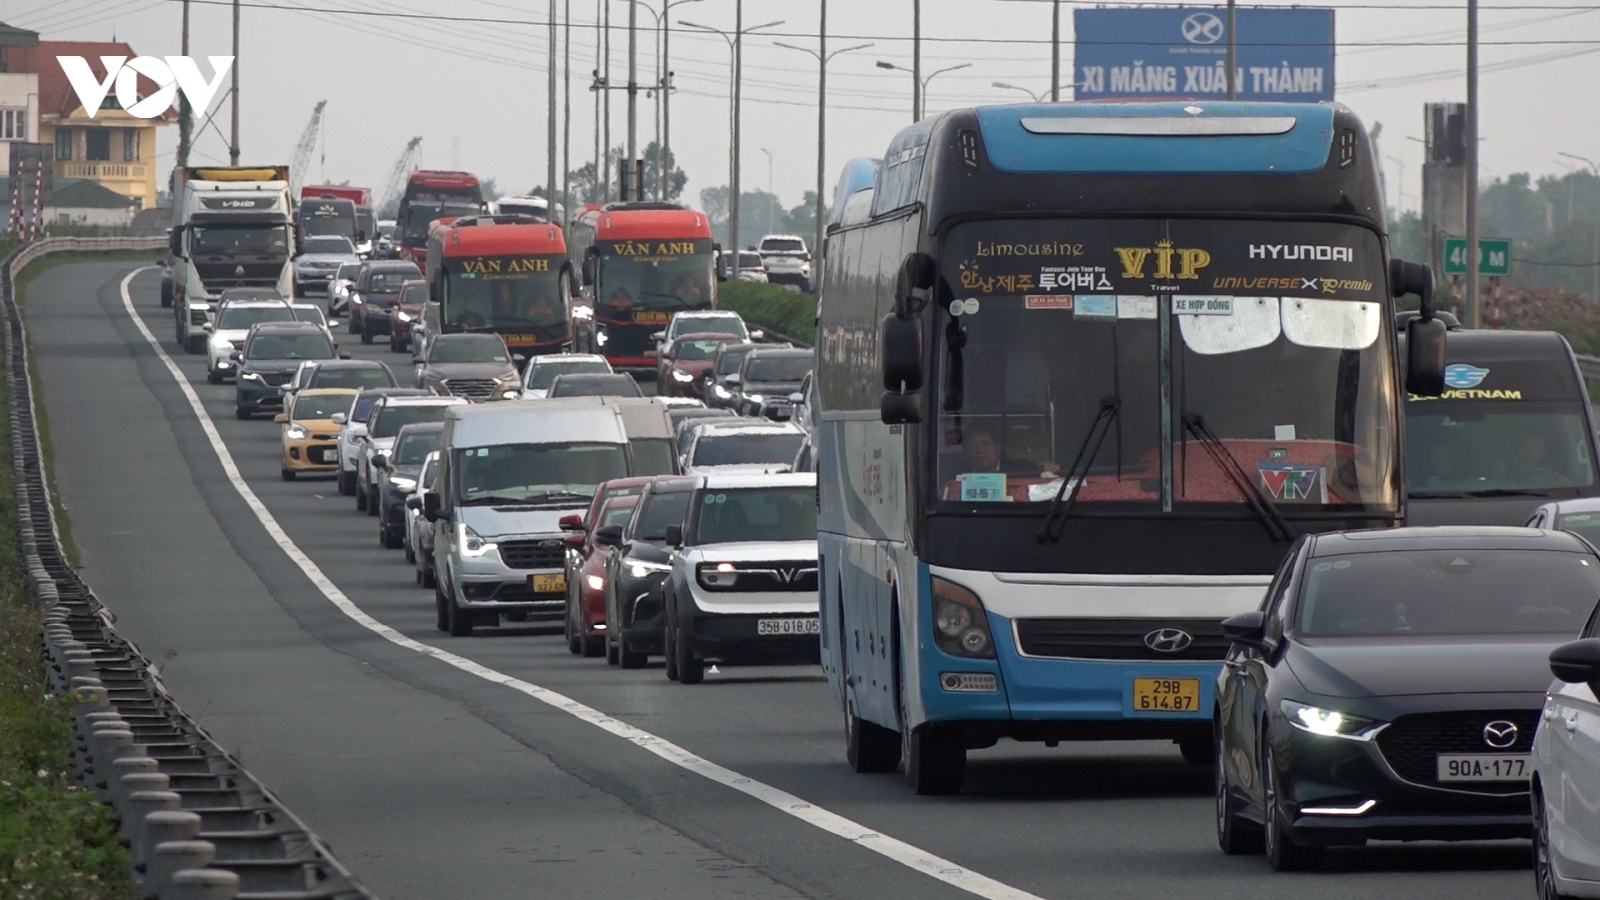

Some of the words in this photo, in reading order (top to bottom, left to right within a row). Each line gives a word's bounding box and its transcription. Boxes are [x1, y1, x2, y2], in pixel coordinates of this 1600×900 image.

[1081, 65, 1105, 93] XI
[1110, 59, 1177, 93] MĂNG
[1249, 61, 1324, 94] THÀNH
[613, 240, 650, 256] VÂN
[656, 242, 695, 255] ANH
[976, 241, 1085, 257] Limousine
[1249, 244, 1353, 263] HYUNDAI
[462, 257, 502, 273] VÂN
[508, 259, 549, 272] ANH
[1113, 243, 1211, 280] VIP
[1489, 250, 1505, 267] M
[1039, 272, 1115, 292] 투어버스
[1150, 283, 1180, 291] Travel
[1175, 300, 1187, 310] XE
[1153, 680, 1181, 694] 29B
[1141, 695, 1192, 710] 614.87
